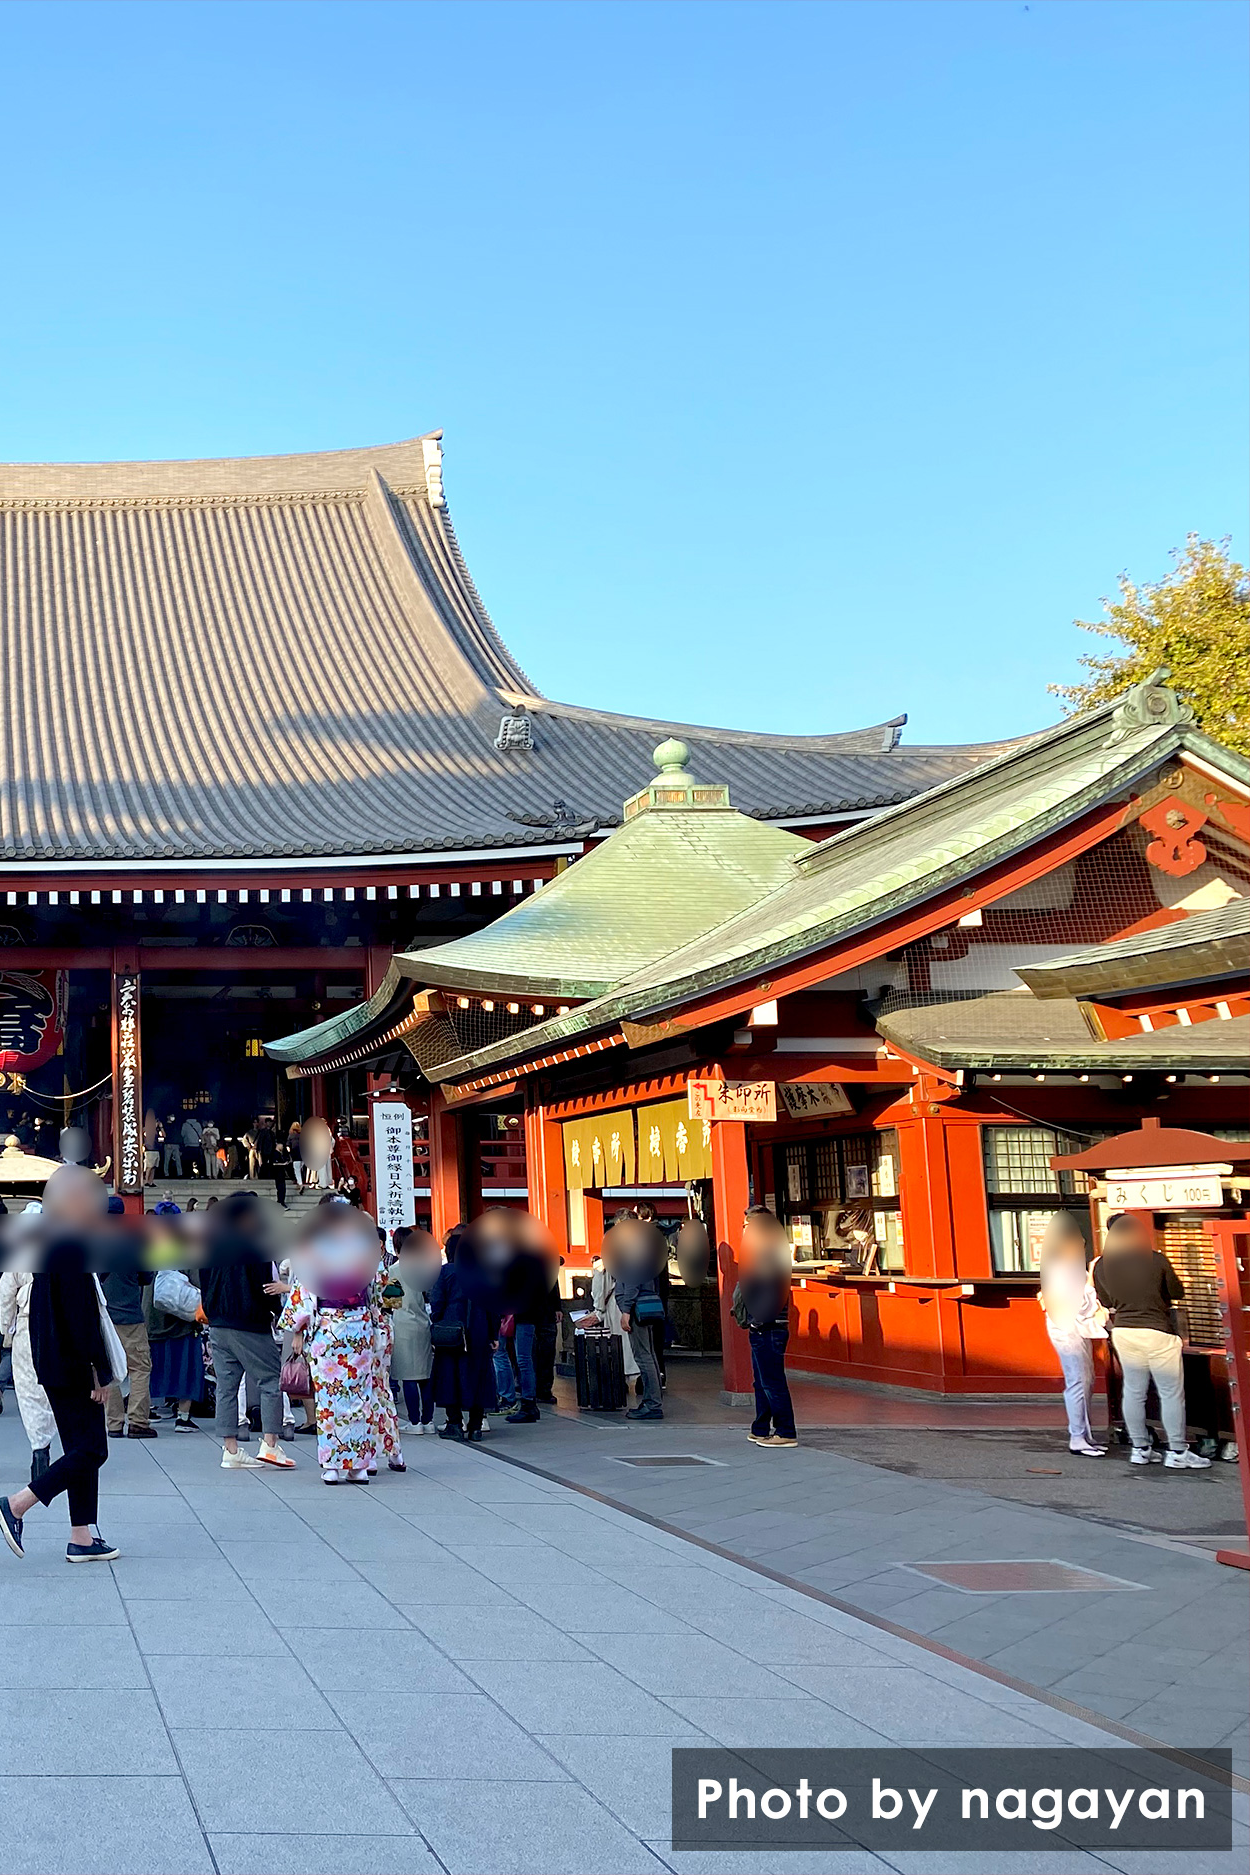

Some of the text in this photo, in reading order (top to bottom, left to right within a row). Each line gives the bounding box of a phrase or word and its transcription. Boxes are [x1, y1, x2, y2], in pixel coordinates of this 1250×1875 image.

[718, 1083, 771, 1105] 朱印所
[380, 1112, 405, 1121] 恒例
[1116, 1183, 1173, 1204] みくじ
